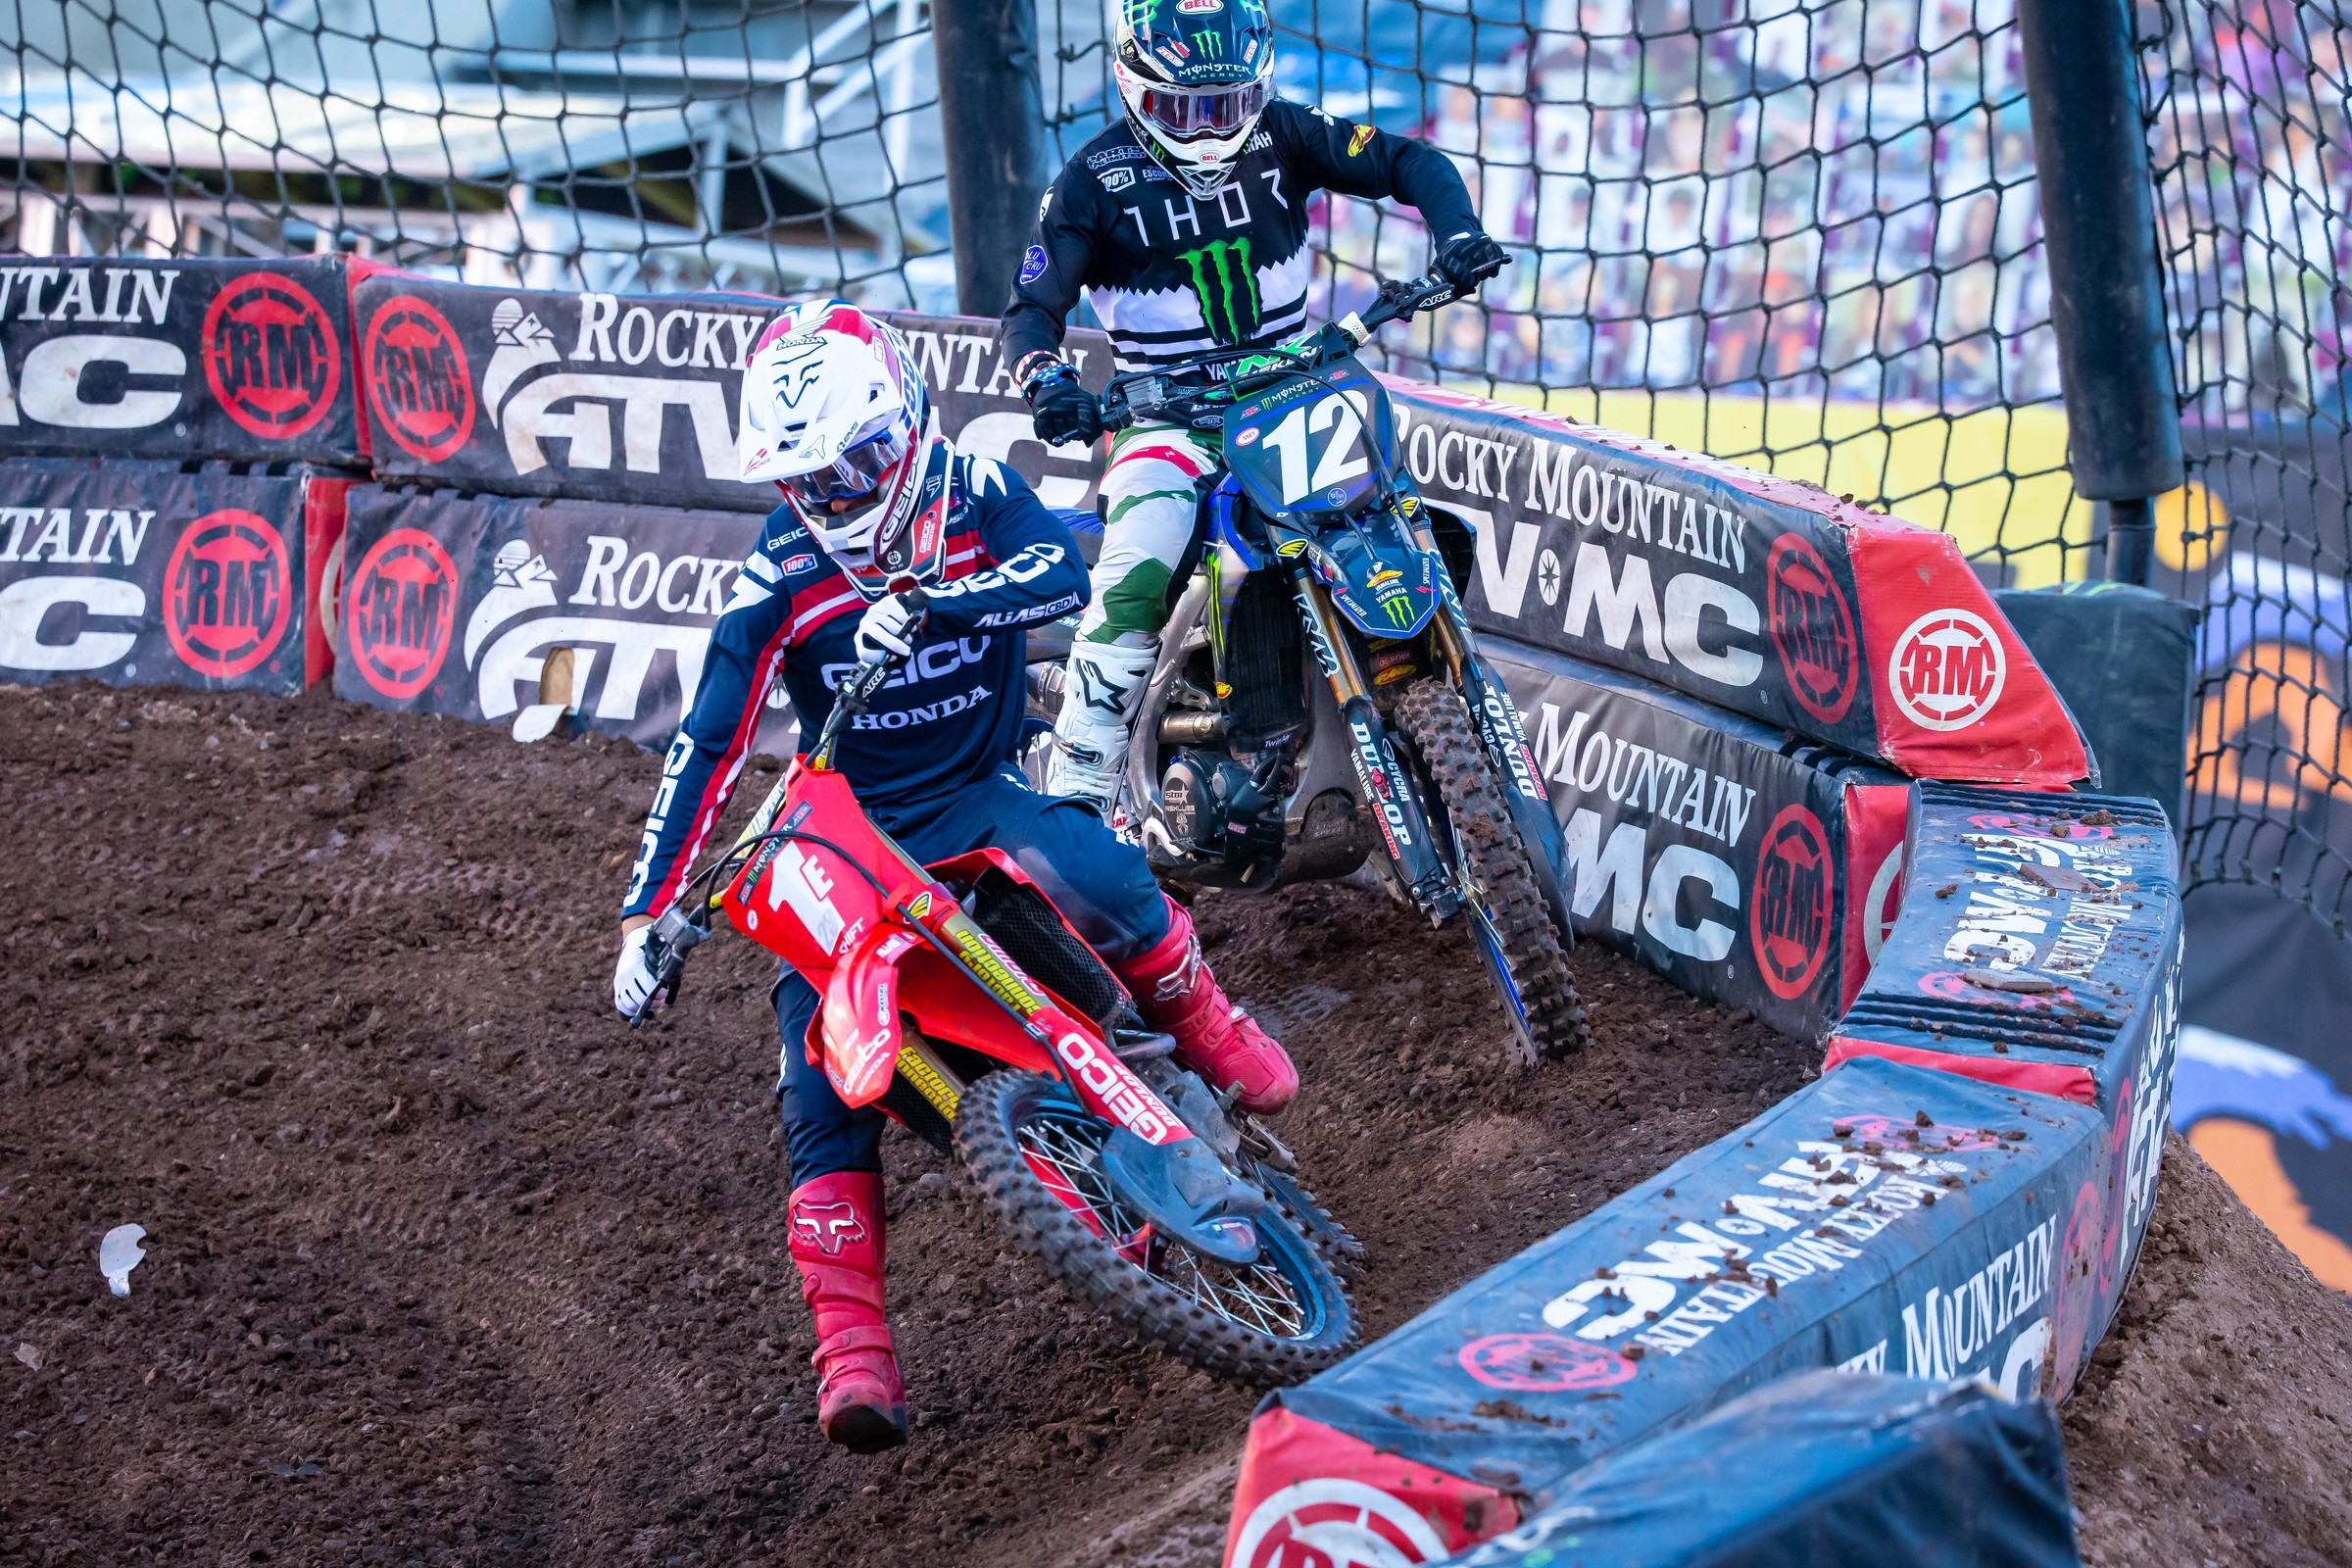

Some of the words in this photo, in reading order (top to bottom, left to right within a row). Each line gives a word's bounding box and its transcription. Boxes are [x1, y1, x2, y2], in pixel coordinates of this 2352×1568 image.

[1178, 62, 1251, 77] MONSTER
[1418, 290, 1452, 308] ARC
[568, 293, 764, 371] ROCKY
[777, 336, 826, 351] HONDA
[1262, 390, 1368, 506] 12
[1524, 436, 1747, 575] MOUNTAIN
[0, 507, 156, 566] TAIN
[766, 526, 809, 551] GEIC
[919, 520, 932, 554] GEICO
[568, 535, 743, 616] ROCK
[785, 556, 813, 572] 100%
[919, 543, 1065, 599] GECO
[1047, 596, 1071, 615] CBD
[1339, 594, 1368, 618] SPECIALIZED
[1376, 587, 1408, 604] YAMAHA
[861, 666, 886, 699] ARC
[1378, 650, 1412, 667] ossner
[1912, 643, 1984, 697] RM
[852, 685, 993, 730] HONDA
[1499, 692, 1528, 743] YAMALUBE
[1350, 748, 1374, 803] YAMALUBE
[1387, 761, 1411, 803] CYCRA
[1518, 743, 1548, 802] BRAKING
[1534, 702, 1757, 848] MOUNTAIN
[754, 822, 794, 873] MONSTR
[1372, 802, 1401, 860] BRAKING
[839, 916, 864, 955] SHIFT
[842, 1028, 892, 1096] GEICO
[855, 1051, 892, 1097] HONDA
[895, 1054, 956, 1121] nnectio
[1057, 1032, 1168, 1146] GEICO
[1112, 1063, 1181, 1128] DUNLOP
[1902, 1213, 2058, 1381] MOUNTAIN
